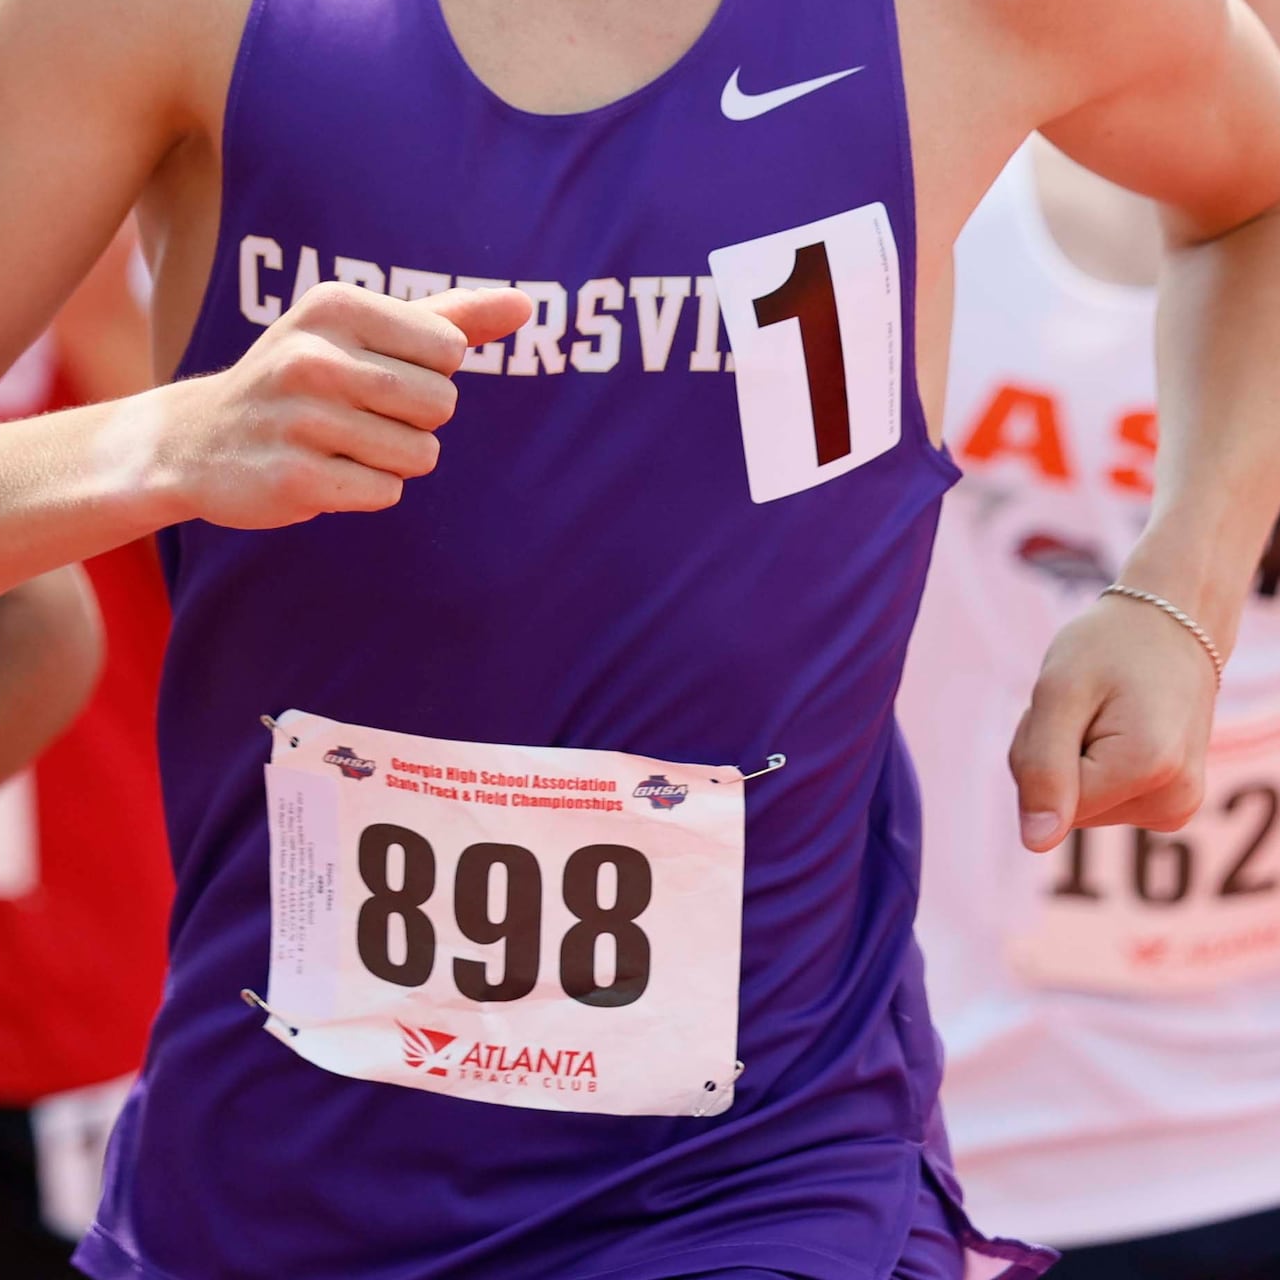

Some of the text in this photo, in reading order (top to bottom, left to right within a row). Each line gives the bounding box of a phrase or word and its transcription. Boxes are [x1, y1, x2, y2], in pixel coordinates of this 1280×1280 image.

[238, 233, 735, 376] CARSVI
[752, 241, 851, 467] 1
[324, 754, 376, 770] GHSA
[391, 757, 616, 792] Georgia High School Association
[386, 774, 623, 812] State Track & Field Championships
[632, 783, 689, 798] GHSA
[356, 823, 652, 1008] 898
[460, 1042, 597, 1078] ATLANTA
[459, 1069, 597, 1093] TRACK CLUB
